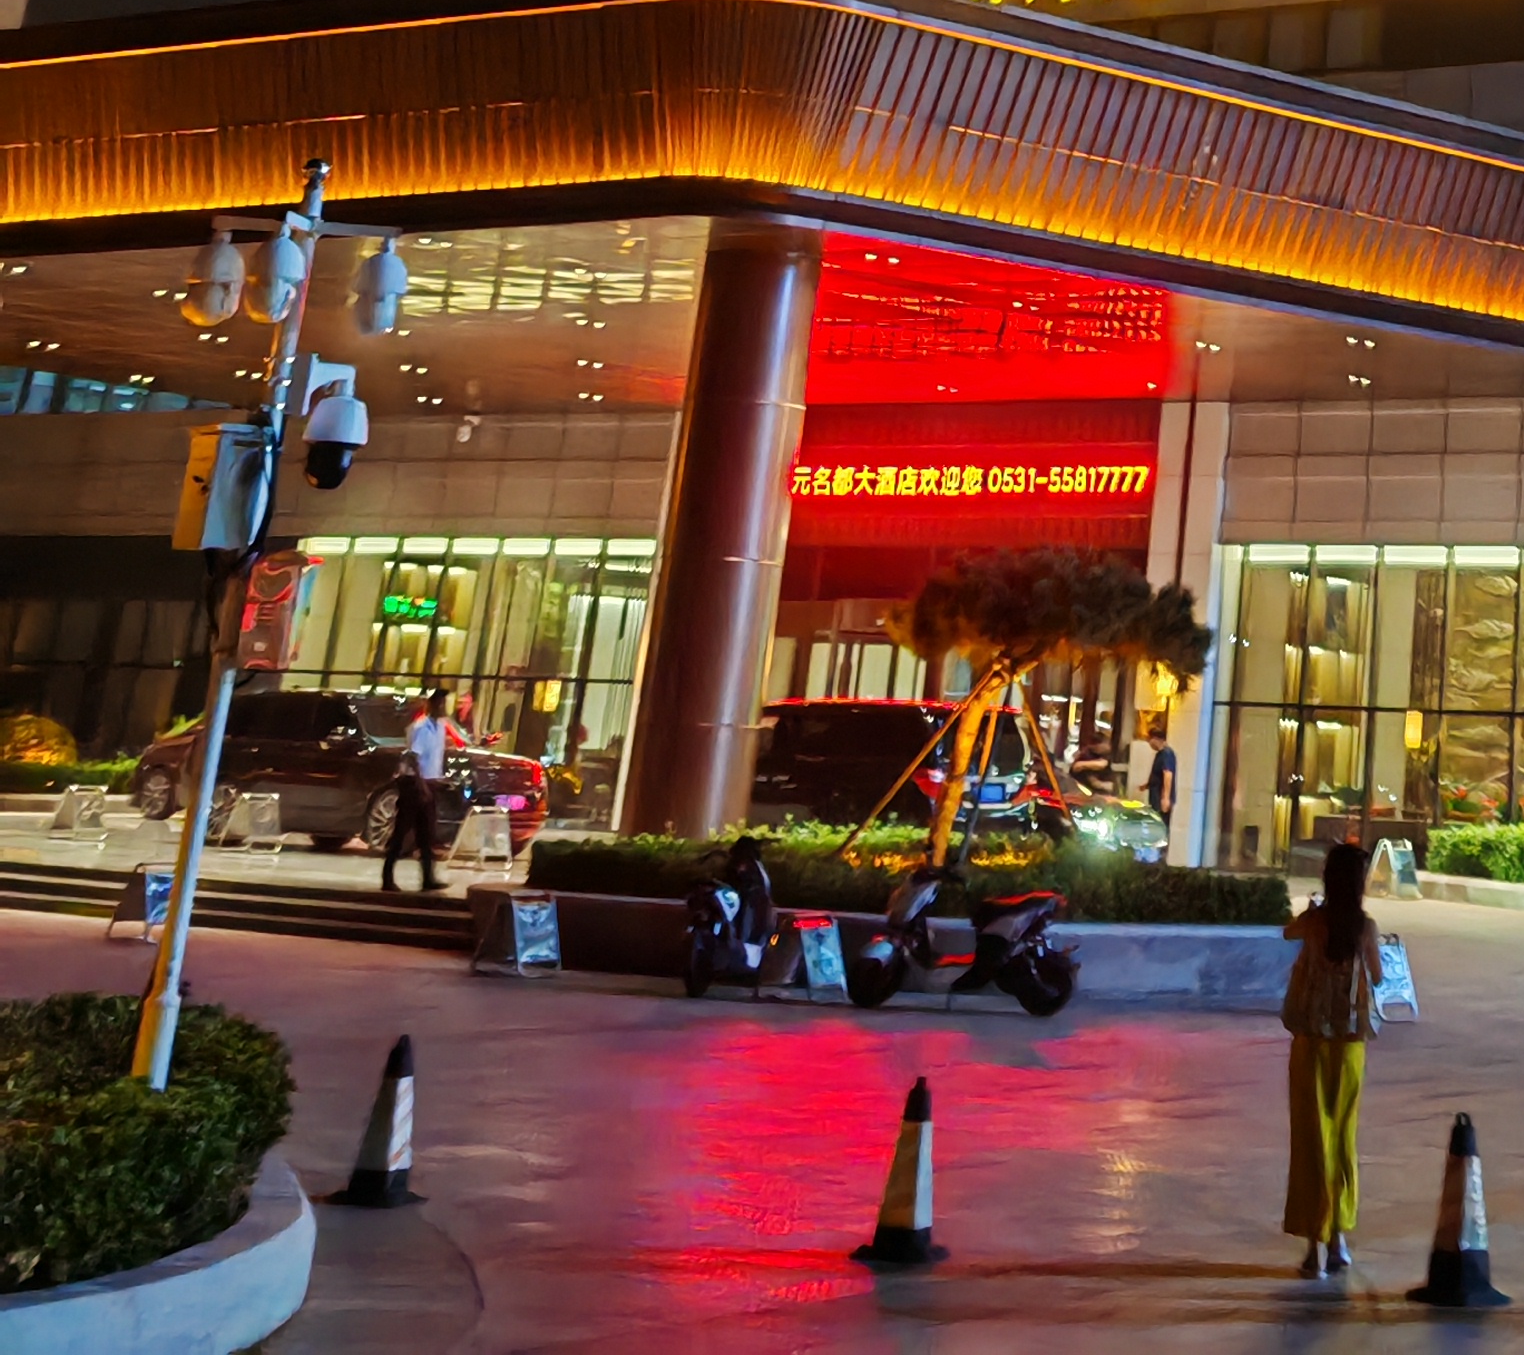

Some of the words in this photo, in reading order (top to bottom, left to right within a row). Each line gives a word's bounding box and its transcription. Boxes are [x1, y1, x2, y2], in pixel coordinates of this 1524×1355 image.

[791, 465, 984, 496] 元名都大酒店欢迎您
[986, 465, 1149, 493] 0531-55817777
